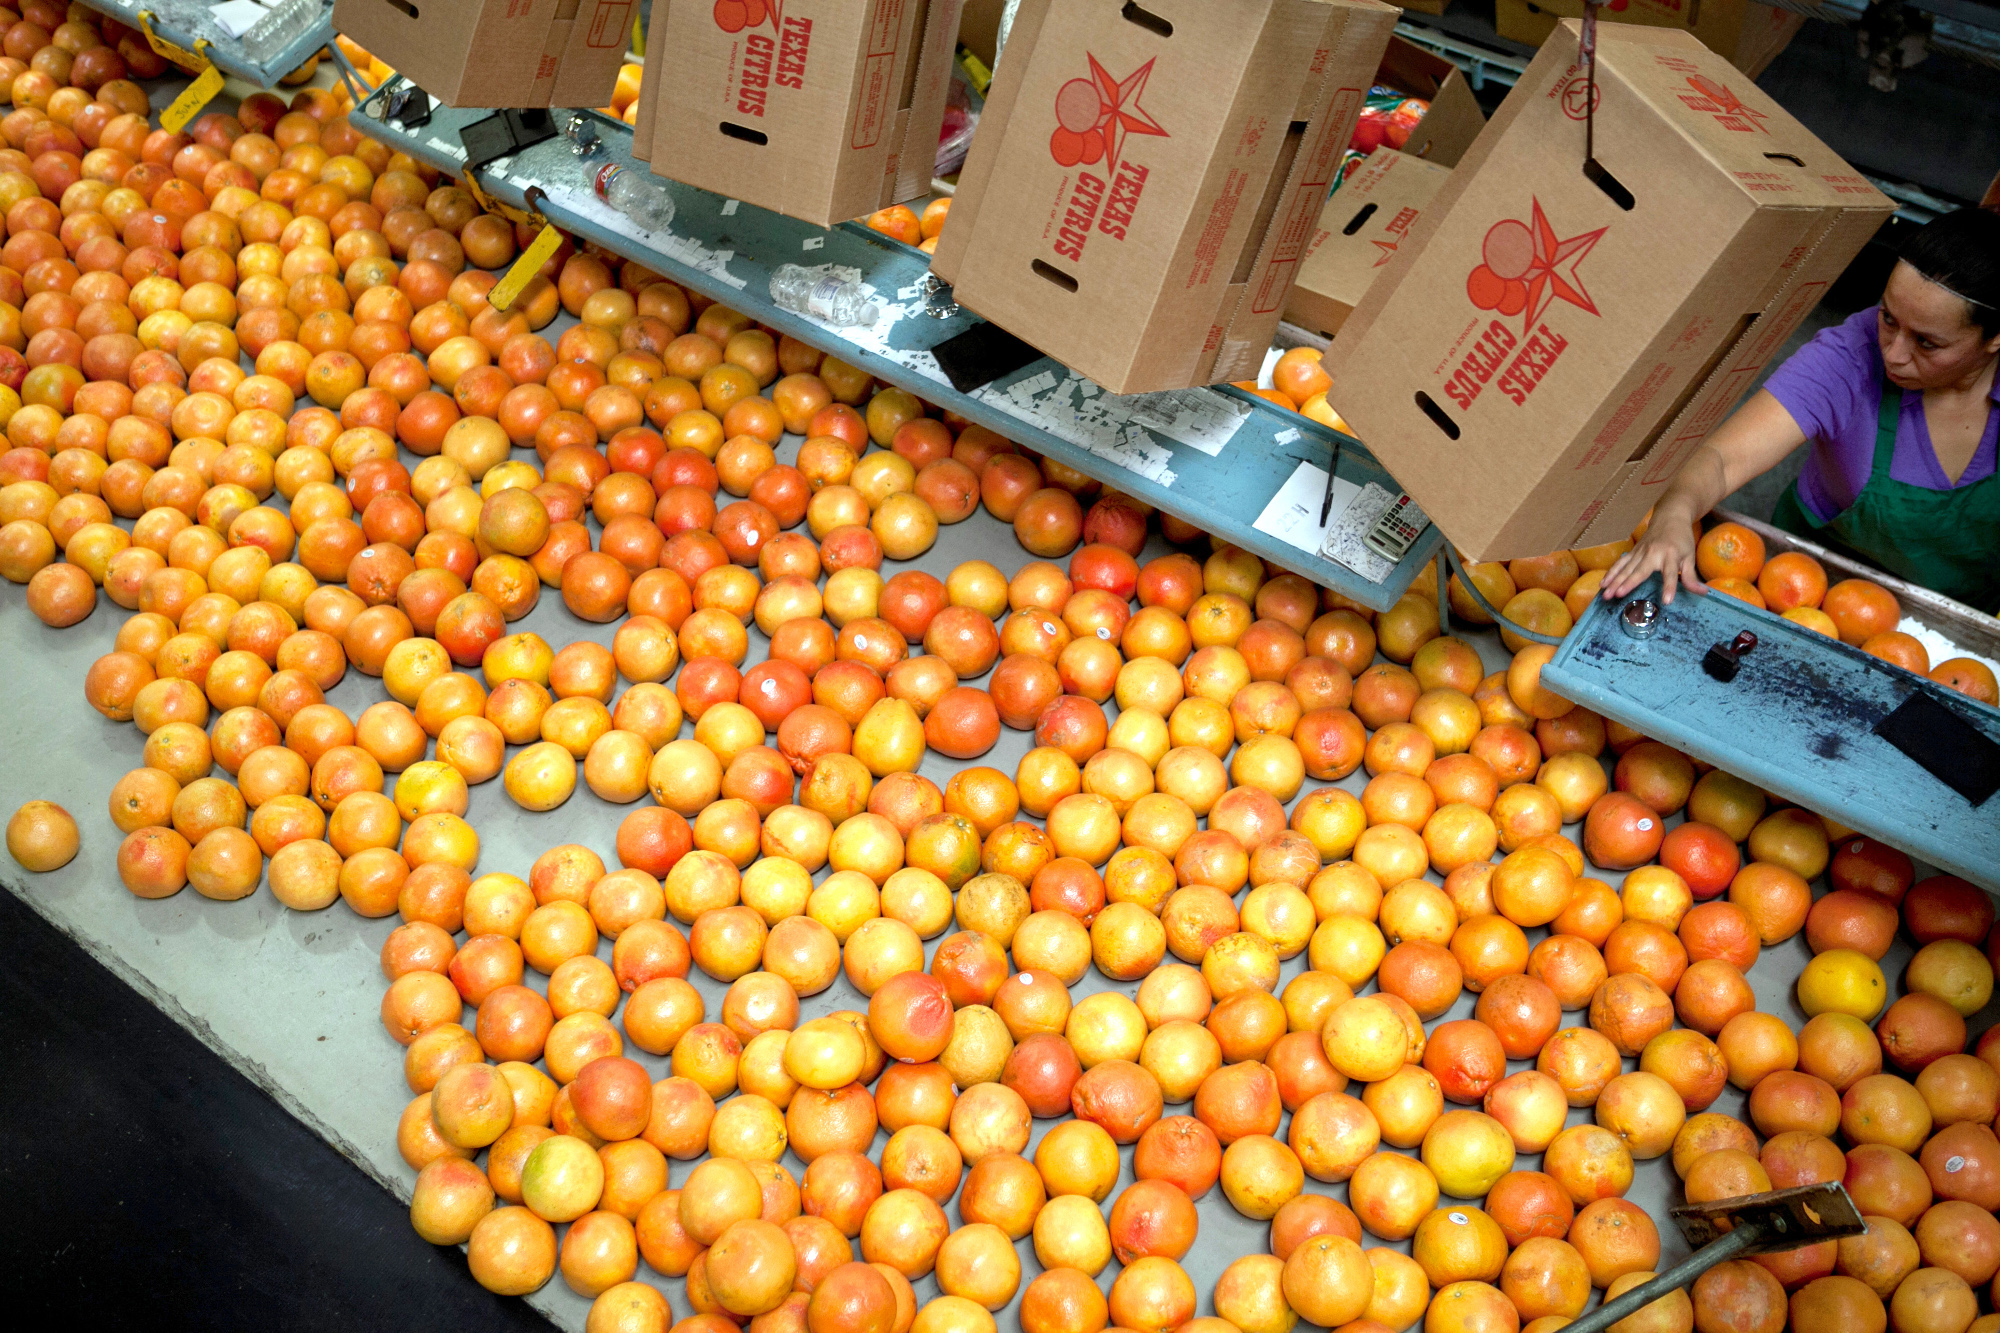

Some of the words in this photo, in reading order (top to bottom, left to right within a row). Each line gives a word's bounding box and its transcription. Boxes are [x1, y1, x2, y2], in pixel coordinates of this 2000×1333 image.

[728, 41, 738, 73] PRODUCE
[775, 16, 813, 90] TEXAS
[727, 74, 733, 83] OF
[737, 34, 776, 118] CITRUS
[1566, 64, 1578, 77] GO
[1054, 175, 1069, 207] PRODUCE
[1098, 160, 1150, 242] TEXAS
[1050, 209, 1057, 220] OF
[1053, 171, 1106, 263] CITRUS
[1385, 206, 1419, 235] TEXAS
[1455, 317, 1479, 347] PRODUCE
[1444, 319, 1518, 411] CITRUS
[1449, 347, 1457, 358] OF
[1497, 323, 1569, 407] TEXAS
